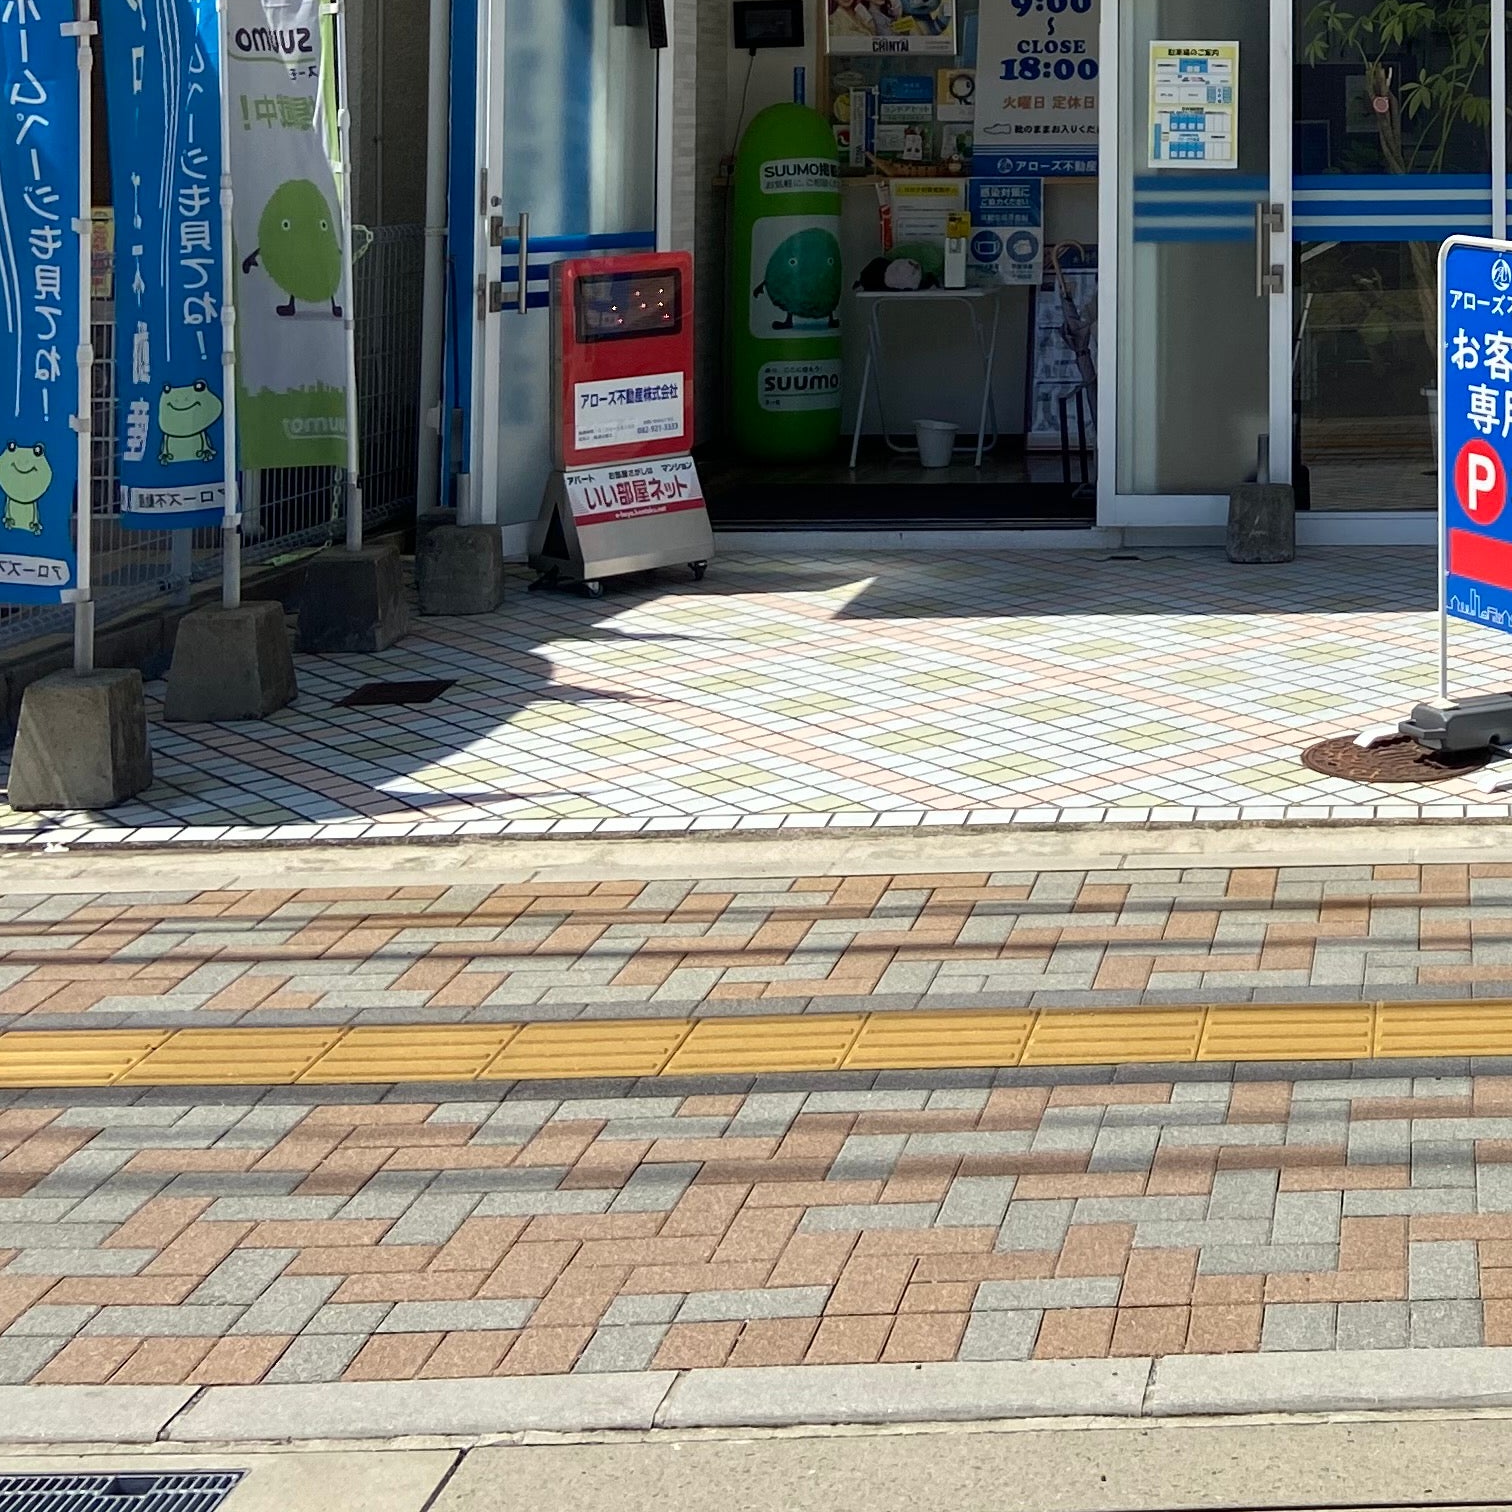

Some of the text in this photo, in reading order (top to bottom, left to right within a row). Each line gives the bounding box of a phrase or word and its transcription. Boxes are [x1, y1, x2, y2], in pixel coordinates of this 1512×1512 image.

[1017, 39, 1086, 54] CLOSE
[1000, 56, 1099, 81] 18:00
[1002, 95, 1095, 110] 火曜日 定休日
[1014, 123, 1099, 135] 靴のままお入りくだ
[1016, 159, 1097, 172] アローズ不動産
[764, 374, 839, 392] suumo
[567, 474, 596, 486] アパート
[661, 461, 692, 472] マンション
[1468, 453, 1496, 512] P
[584, 474, 687, 510] いい部屋ネット
